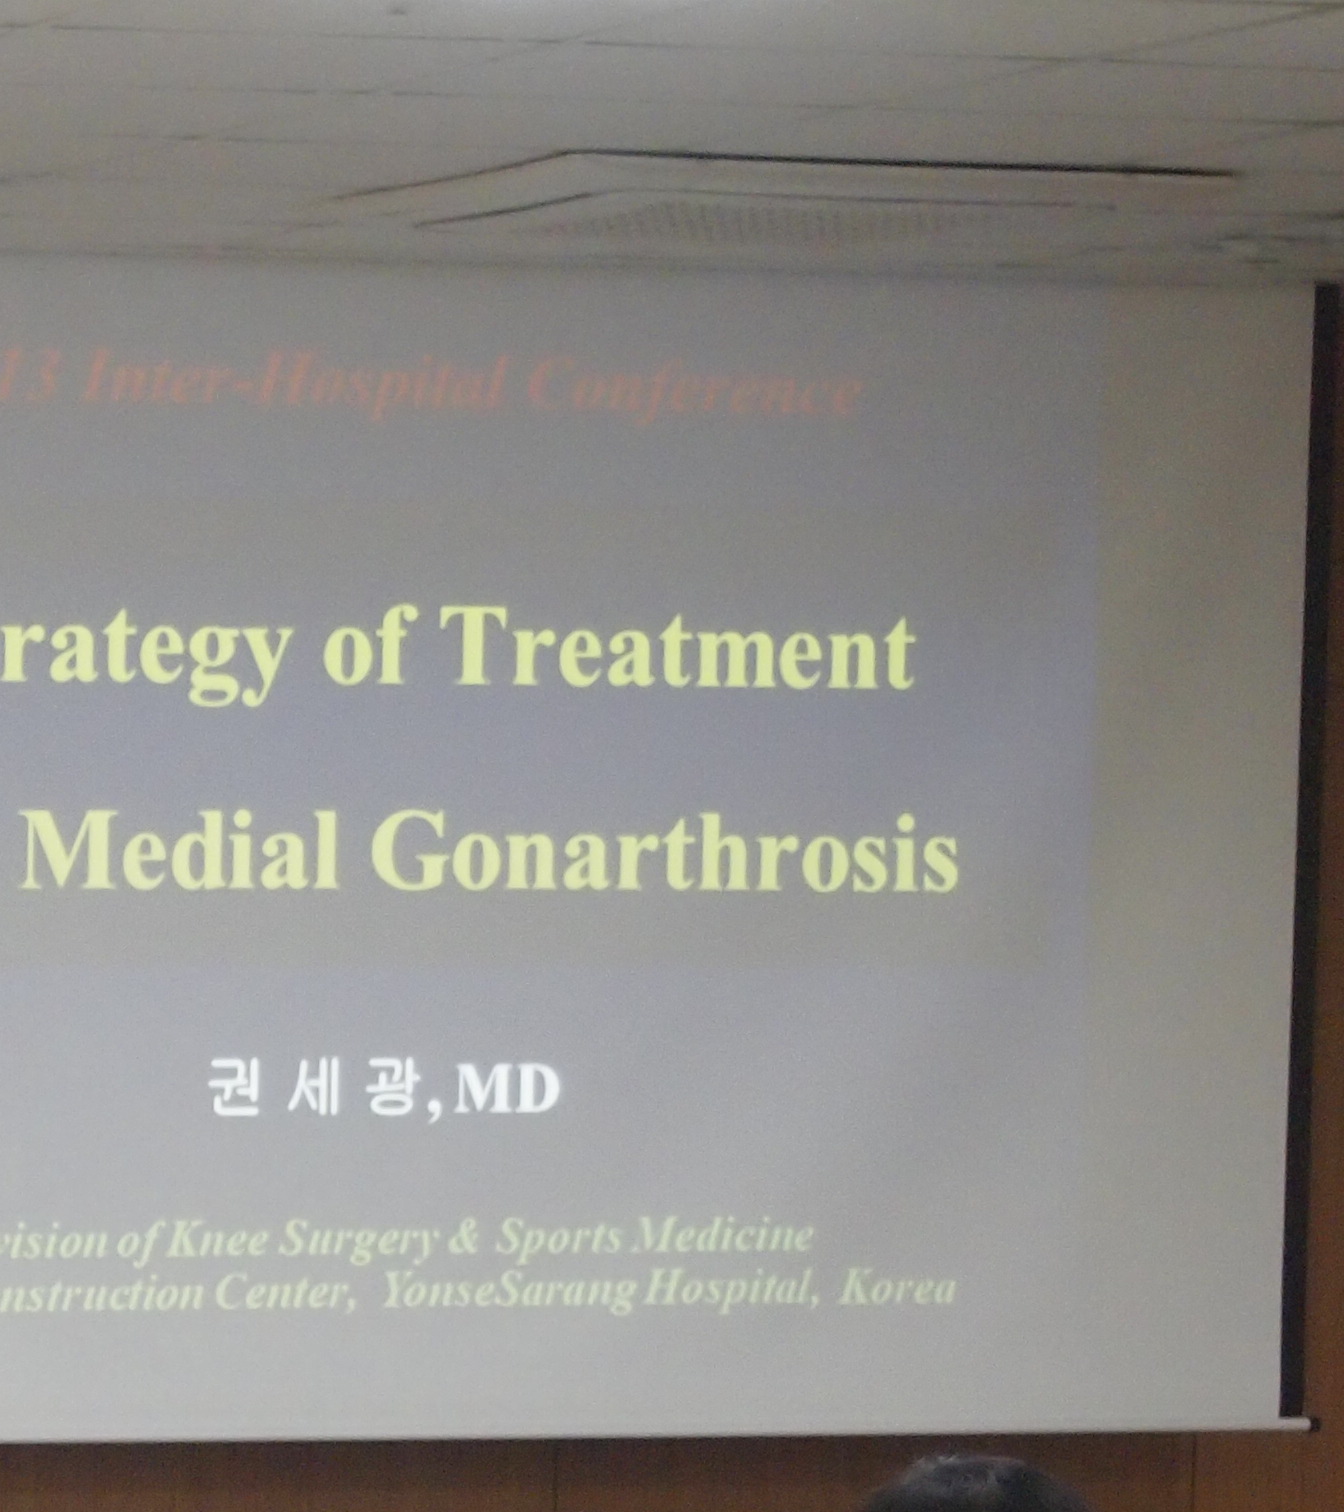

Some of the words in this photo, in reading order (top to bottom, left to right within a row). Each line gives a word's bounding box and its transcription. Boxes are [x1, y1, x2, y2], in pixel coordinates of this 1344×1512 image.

[80, 346, 512, 424] Inter-Hospital
[526, 354, 866, 426] Conference
[323, 604, 419, 685] of
[440, 605, 916, 690] Treatment
[18, 809, 339, 891] Medial
[371, 809, 960, 893] Gonarthrosis
[208, 1057, 260, 1116] 권
[287, 1056, 339, 1116] 세
[117, 1220, 165, 1268] of
[166, 1219, 269, 1258] Knee
[279, 1218, 441, 1266] Surgery
[448, 1217, 479, 1255] &
[495, 1217, 624, 1266] Sports
[631, 1215, 814, 1253] Medicine
[215, 1271, 356, 1314] Center,
[384, 1269, 639, 1316] YonseSarang
[646, 1267, 819, 1315] Hospital,
[838, 1267, 958, 1306] Korea
